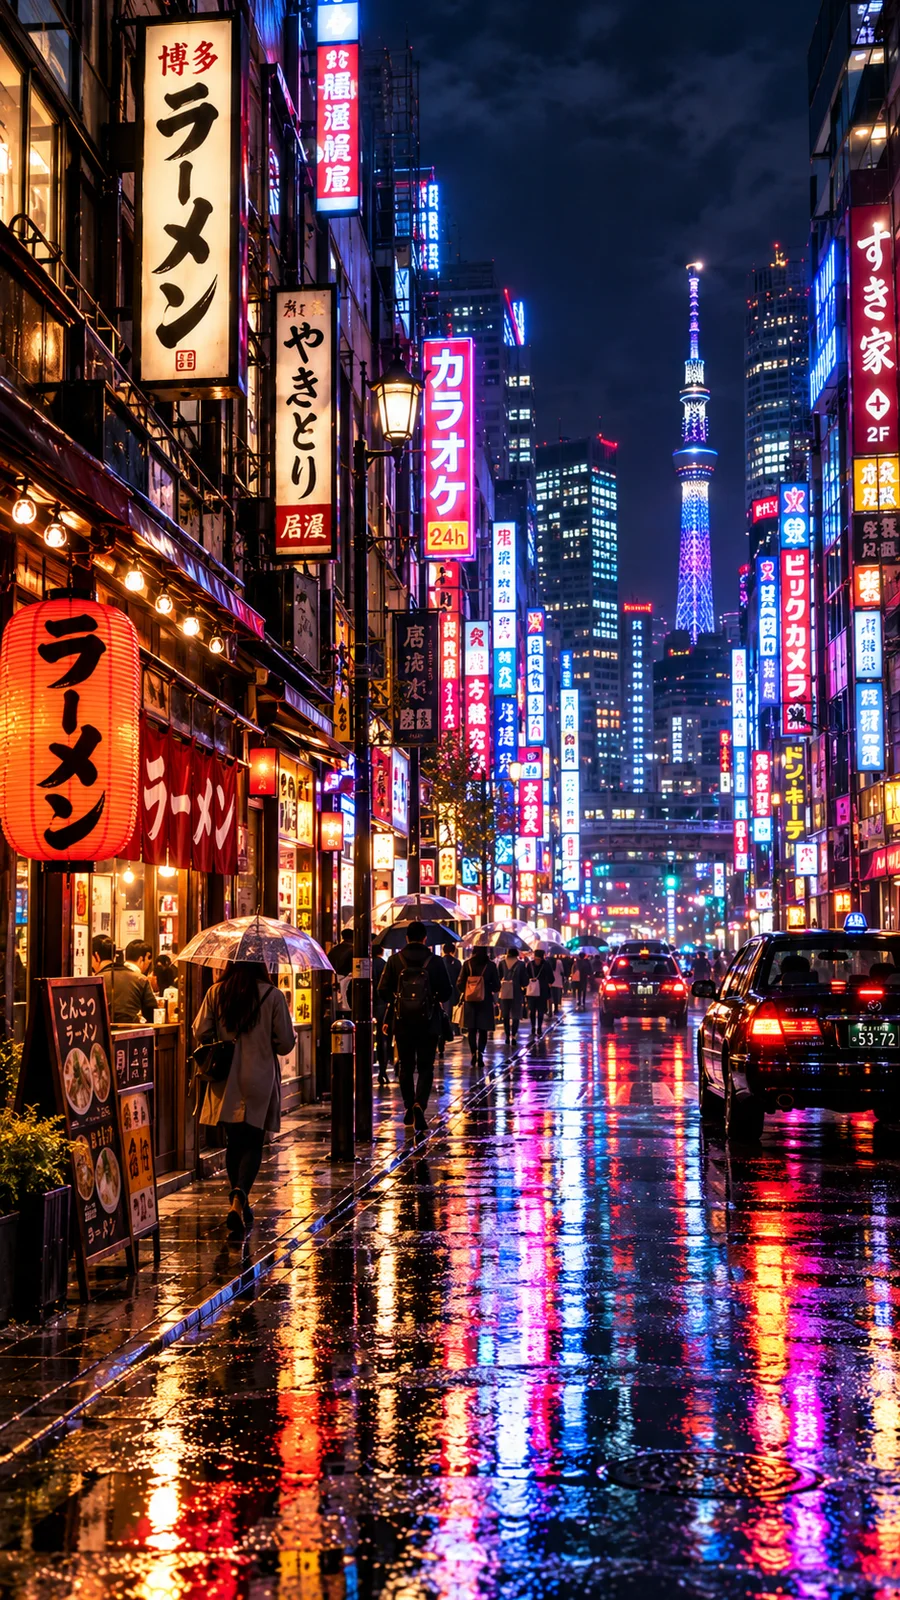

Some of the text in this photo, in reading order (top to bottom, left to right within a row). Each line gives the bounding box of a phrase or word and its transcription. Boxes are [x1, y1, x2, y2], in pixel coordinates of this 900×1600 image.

[158, 41, 218, 75] 博多
[152, 82, 219, 349] ラーメン
[856, 221, 895, 375] すき家
[283, 321, 325, 500] やきとり
[430, 348, 466, 516] カラオケ
[867, 428, 889, 442] 2F
[430, 526, 465, 546] 24h
[37, 614, 106, 851] ラーメン
[143, 755, 235, 850] ラーメン
[59, 997, 97, 1020] とんこつ
[66, 1023, 98, 1046] ラーメン
[858, 1032, 896, 1046] 53-72
